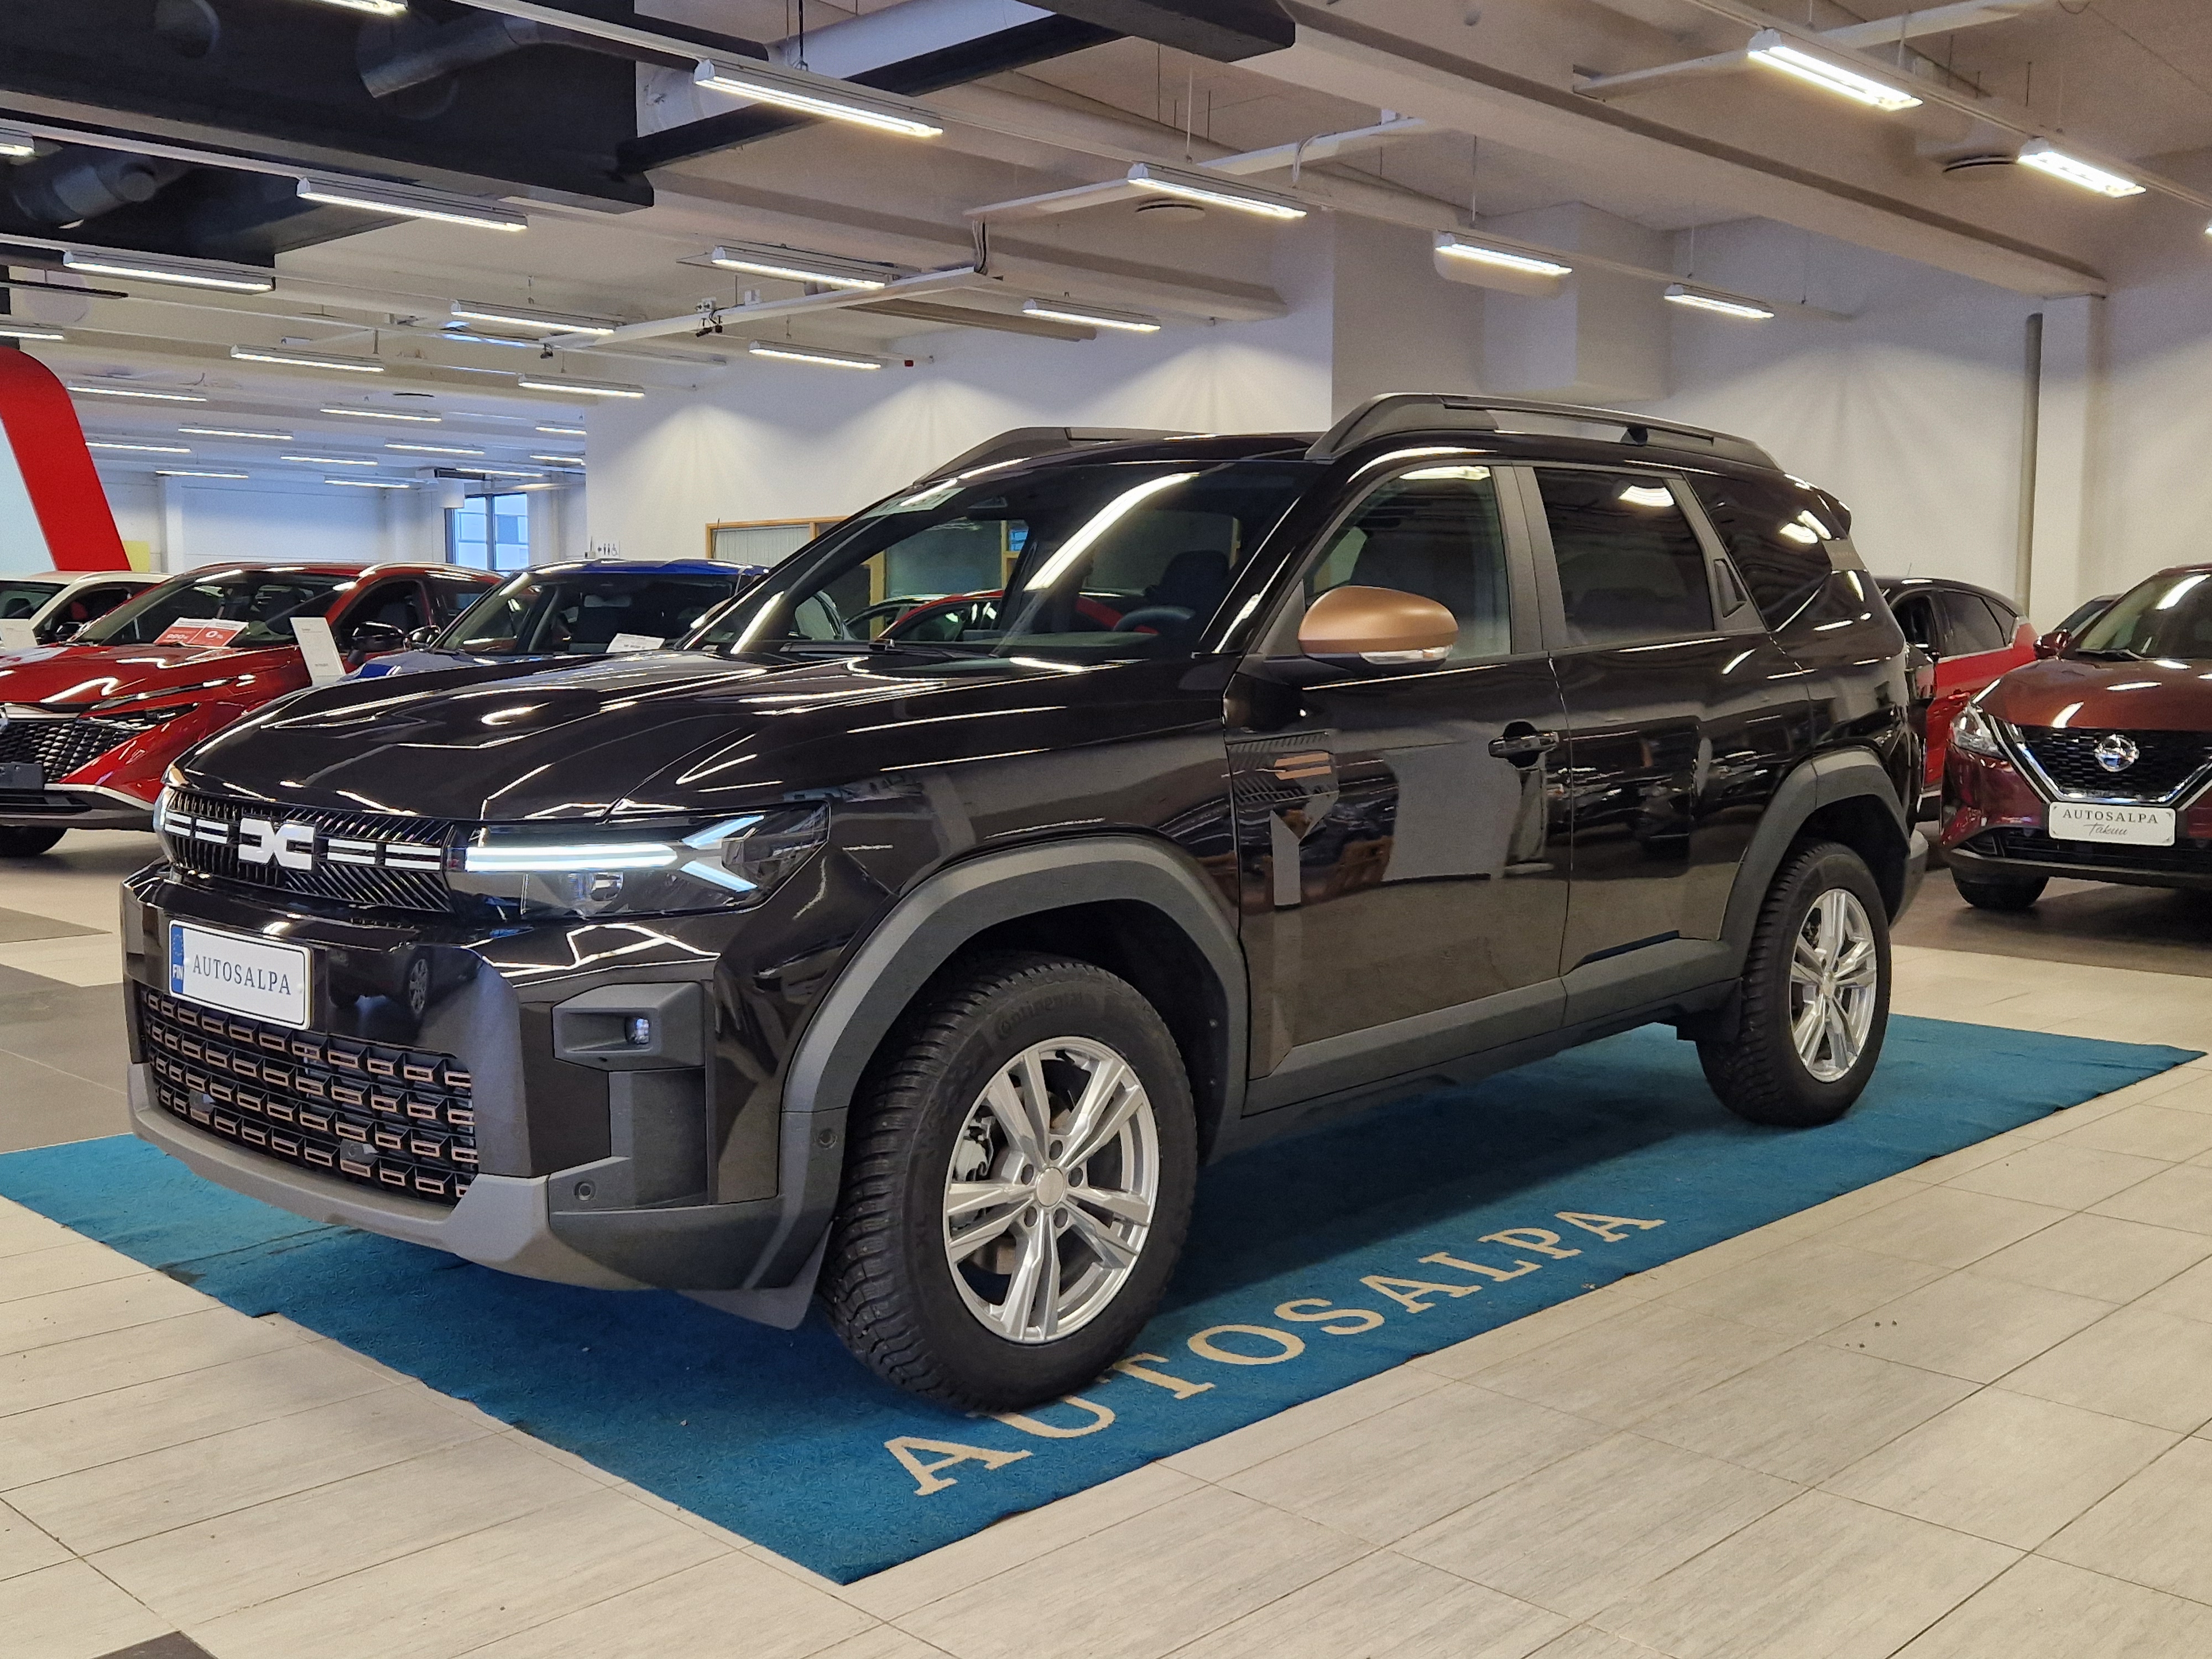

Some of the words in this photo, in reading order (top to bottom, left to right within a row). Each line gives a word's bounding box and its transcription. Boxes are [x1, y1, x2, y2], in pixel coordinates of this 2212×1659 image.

[2062, 809, 2158, 824] AUTOSALPA
[172, 964, 183, 980] FIN
[192, 954, 291, 995] AUTOSALPA
[885, 1211, 1667, 1496] AUTOSALPA
